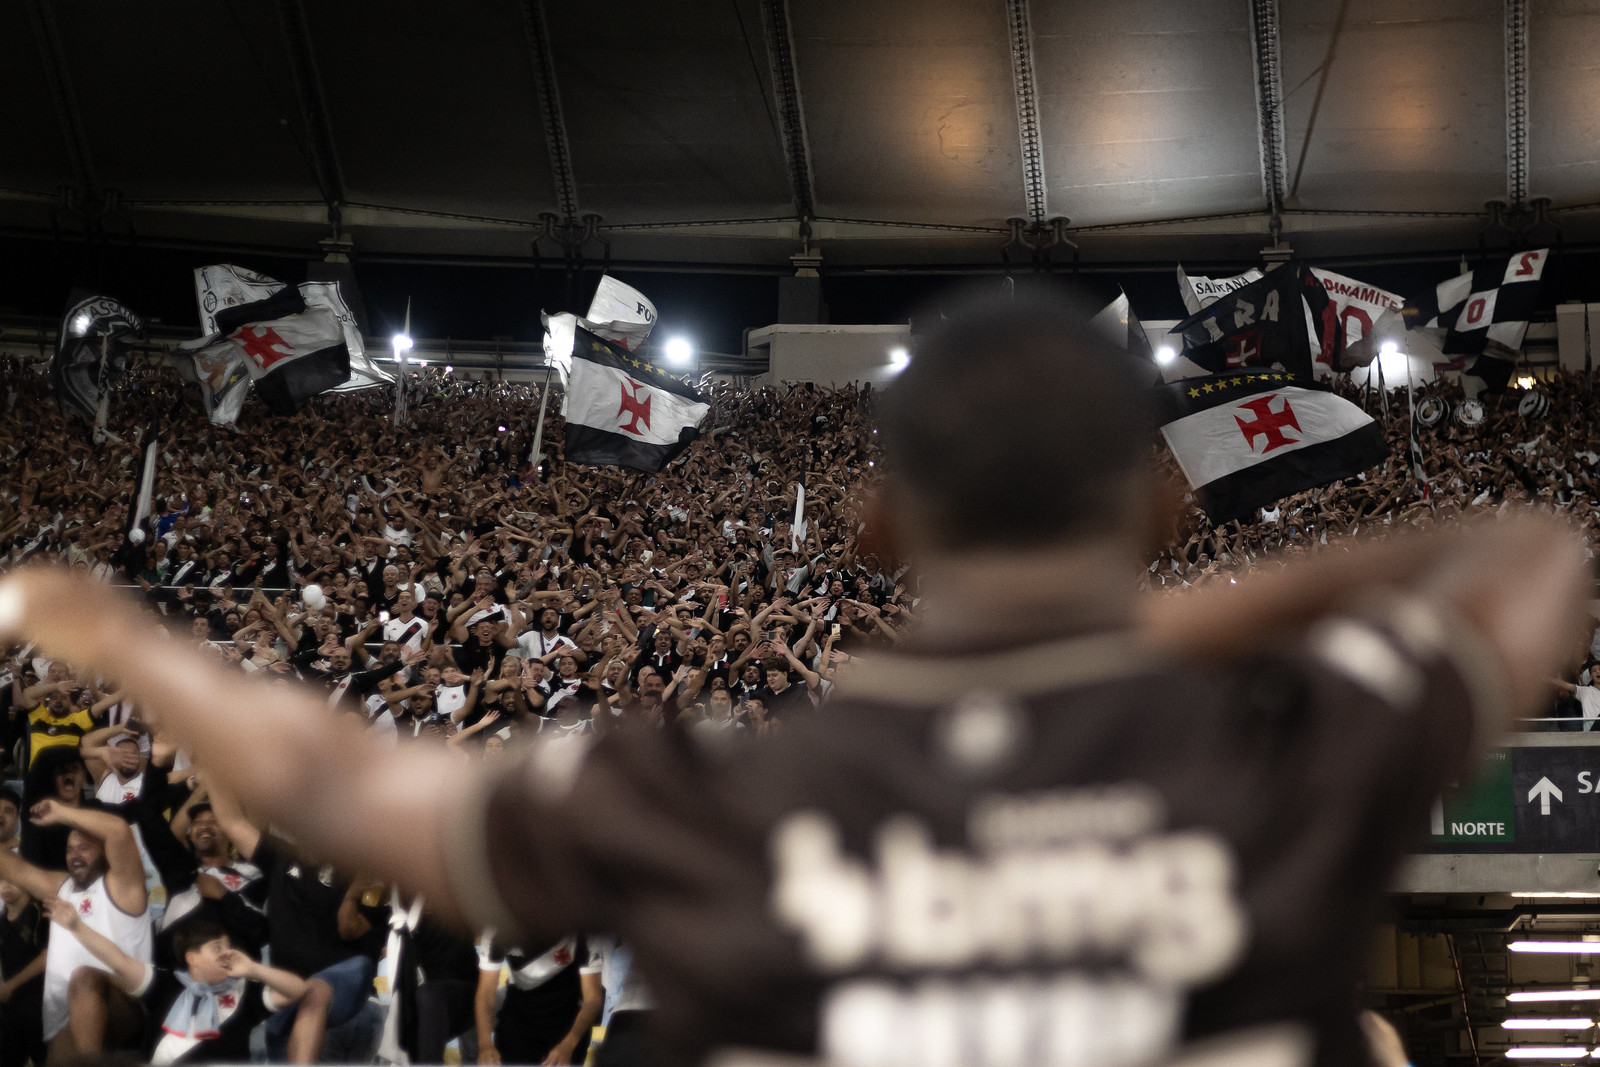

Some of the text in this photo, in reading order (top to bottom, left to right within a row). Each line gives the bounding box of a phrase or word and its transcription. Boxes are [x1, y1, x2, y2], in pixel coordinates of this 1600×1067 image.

[1195, 277, 1250, 295] SANTANA
[1323, 278, 1399, 311] DINAMITE
[1315, 299, 1373, 367] 10
[1577, 771, 1600, 794] S
[1451, 822, 1505, 836] NORTE
